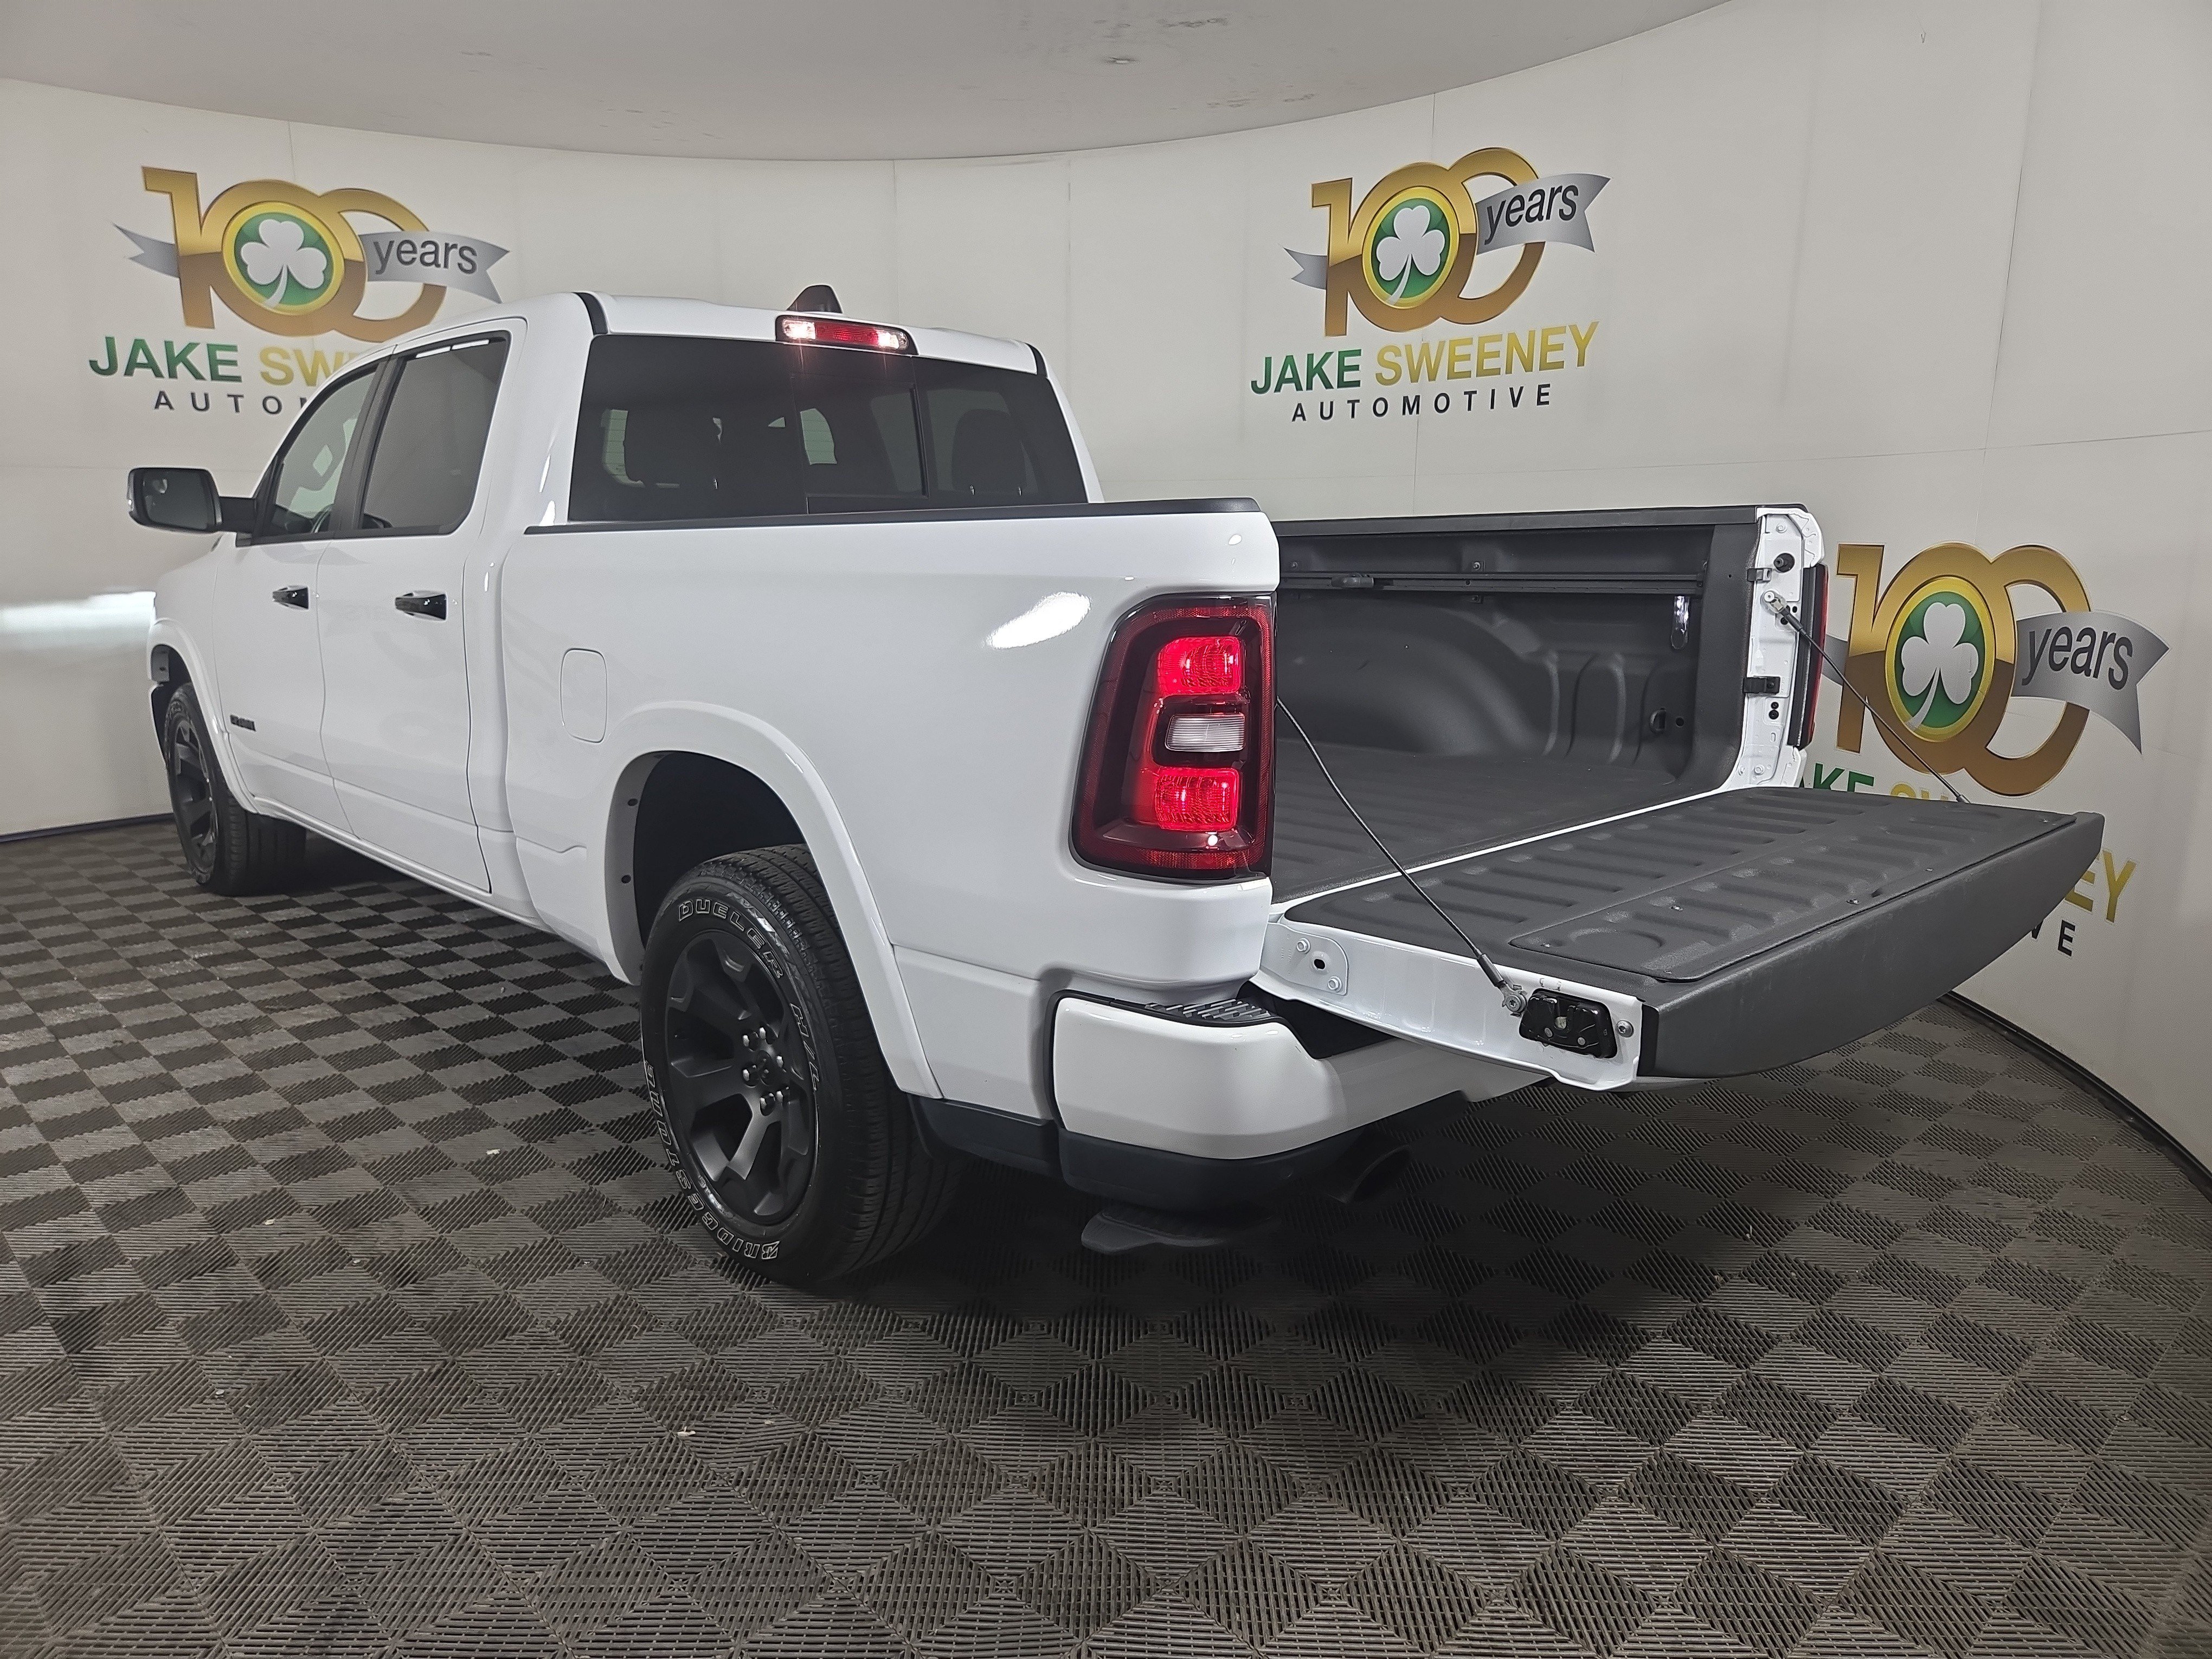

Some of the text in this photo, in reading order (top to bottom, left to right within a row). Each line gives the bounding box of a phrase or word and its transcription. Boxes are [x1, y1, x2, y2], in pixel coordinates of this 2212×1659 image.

[1484, 183, 1579, 246] years
[374, 239, 479, 274] years
[89, 336, 242, 383] JAKE
[1251, 321, 1599, 395] JAKE SWEENEY
[1291, 383, 1551, 422] AUTOMOTIVE
[2022, 625, 2133, 691] years
[679, 898, 783, 979] DUELER
[645, 1061, 780, 1260] BRIDGESTONE
